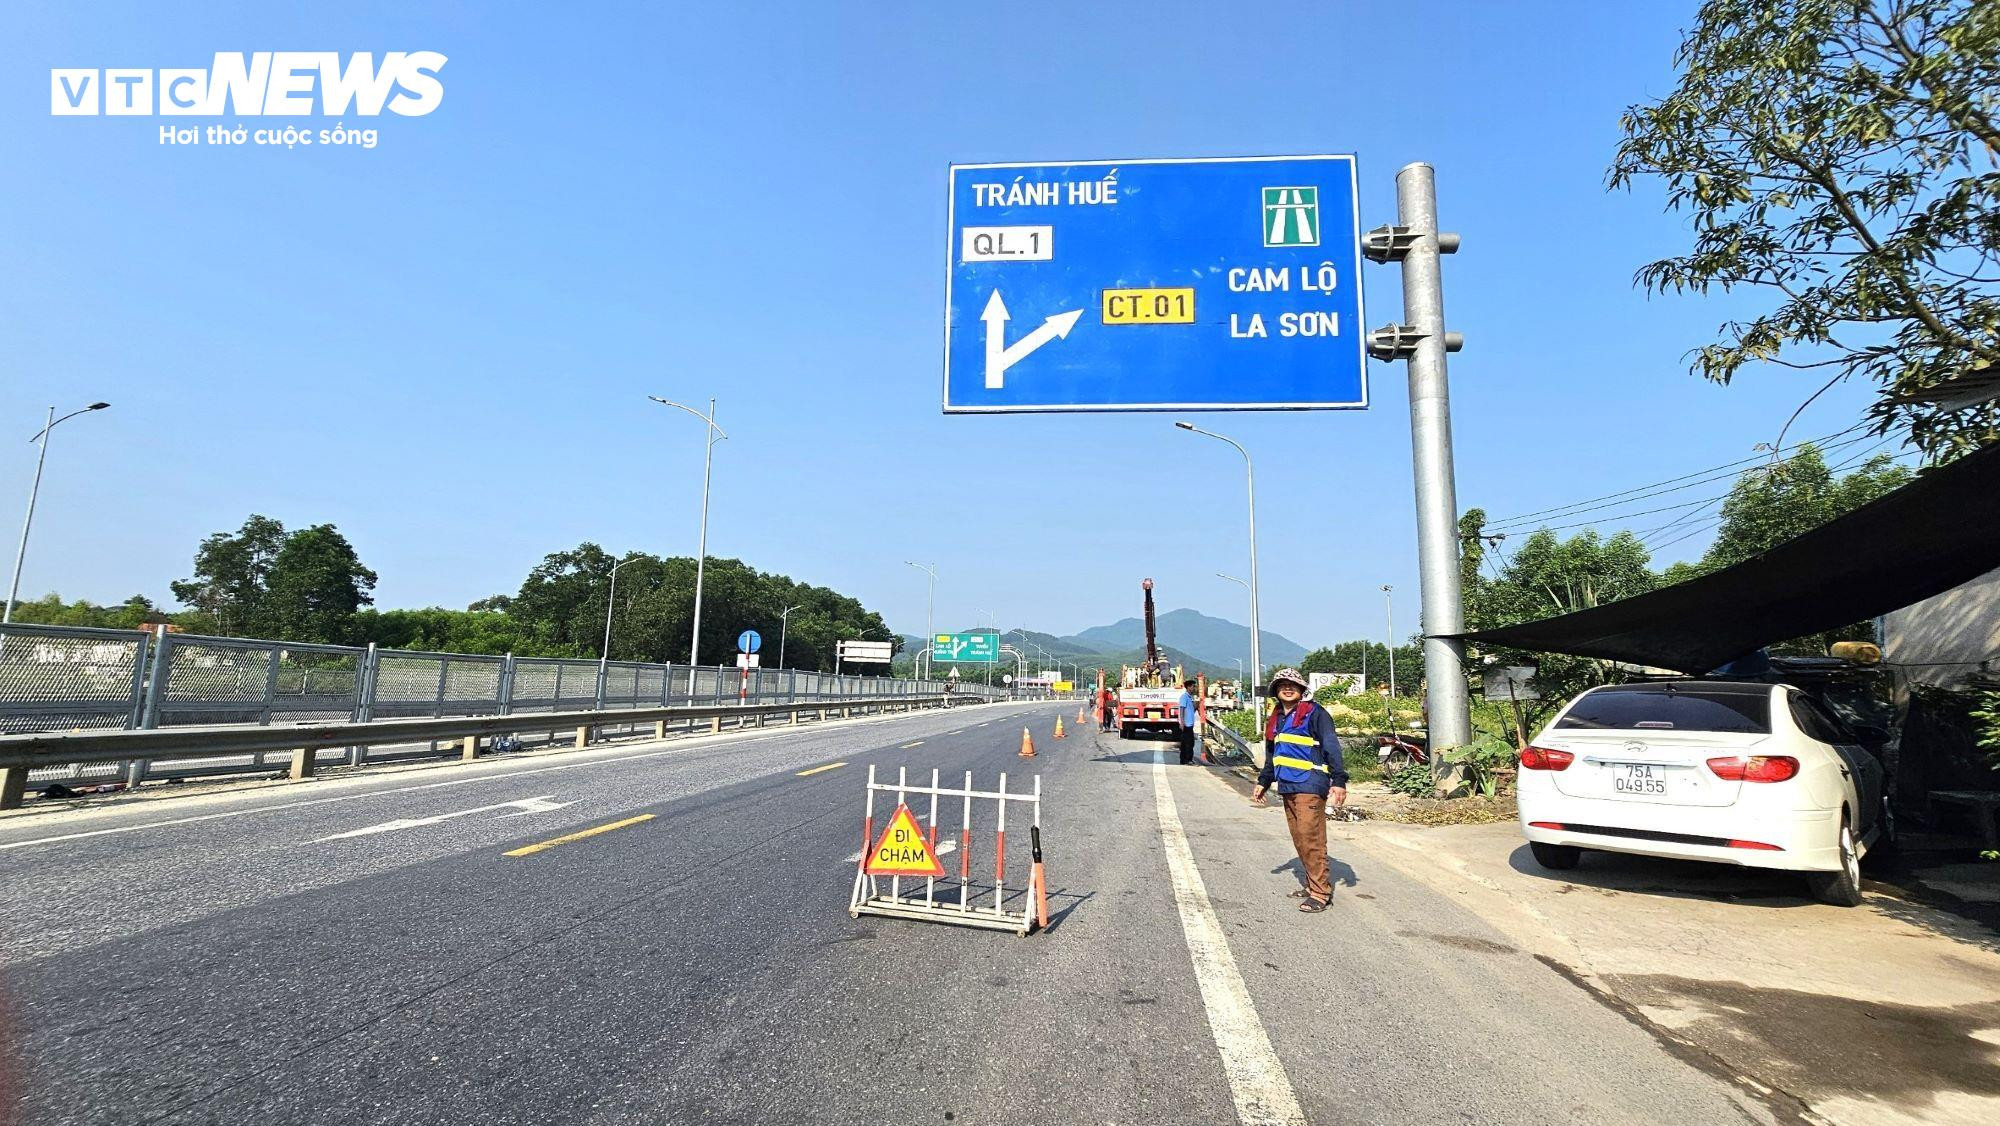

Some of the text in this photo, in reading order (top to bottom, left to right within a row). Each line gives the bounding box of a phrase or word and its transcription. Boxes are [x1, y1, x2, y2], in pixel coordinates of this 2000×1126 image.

[971, 168, 1119, 207] TRÁNH HUẾ
[973, 232, 1041, 256] QL.1
[1228, 261, 1337, 296] CAM LỘ
[1108, 294, 1186, 318] CT.01
[1230, 311, 1339, 338] LA SƠN
[1625, 765, 1653, 778] 75A
[1616, 778, 1665, 793] 049.55
[895, 829, 910, 843] ĐI
[879, 846, 924, 865] CHẬM
